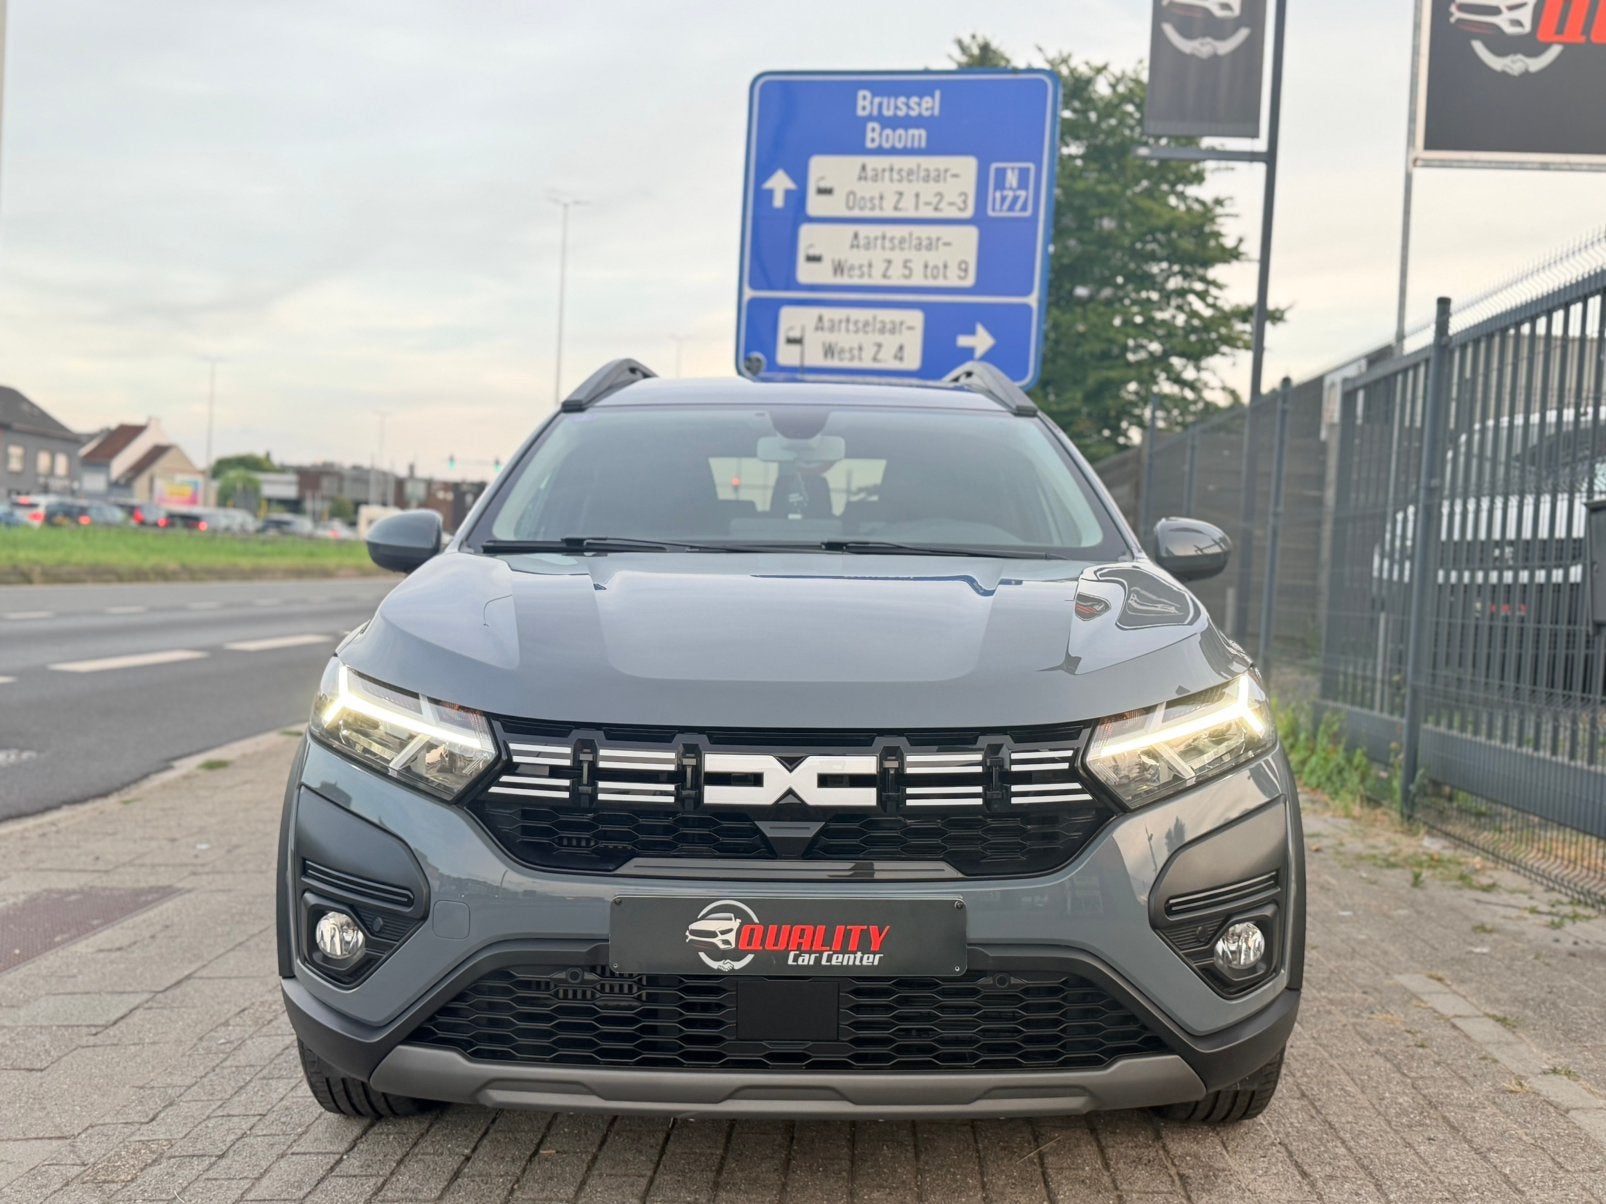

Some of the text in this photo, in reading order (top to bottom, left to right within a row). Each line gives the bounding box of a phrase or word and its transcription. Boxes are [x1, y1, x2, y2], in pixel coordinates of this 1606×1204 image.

[856, 89, 941, 117] Brussel
[865, 121, 928, 149] Boom
[857, 163, 961, 184] Aartselaar-
[1004, 168, 1019, 189] N
[845, 191, 885, 212] Oost
[994, 190, 1027, 212] 177
[849, 231, 953, 252] Aartselaar-
[831, 258, 874, 279] West
[922, 261, 949, 280] tot
[957, 260, 970, 281] 9
[814, 314, 916, 335] Aartselaar-
[822, 341, 864, 363] West
[893, 344, 905, 364] 4
[738, 924, 891, 952] QUALITY
[787, 951, 884, 966] Car Center
